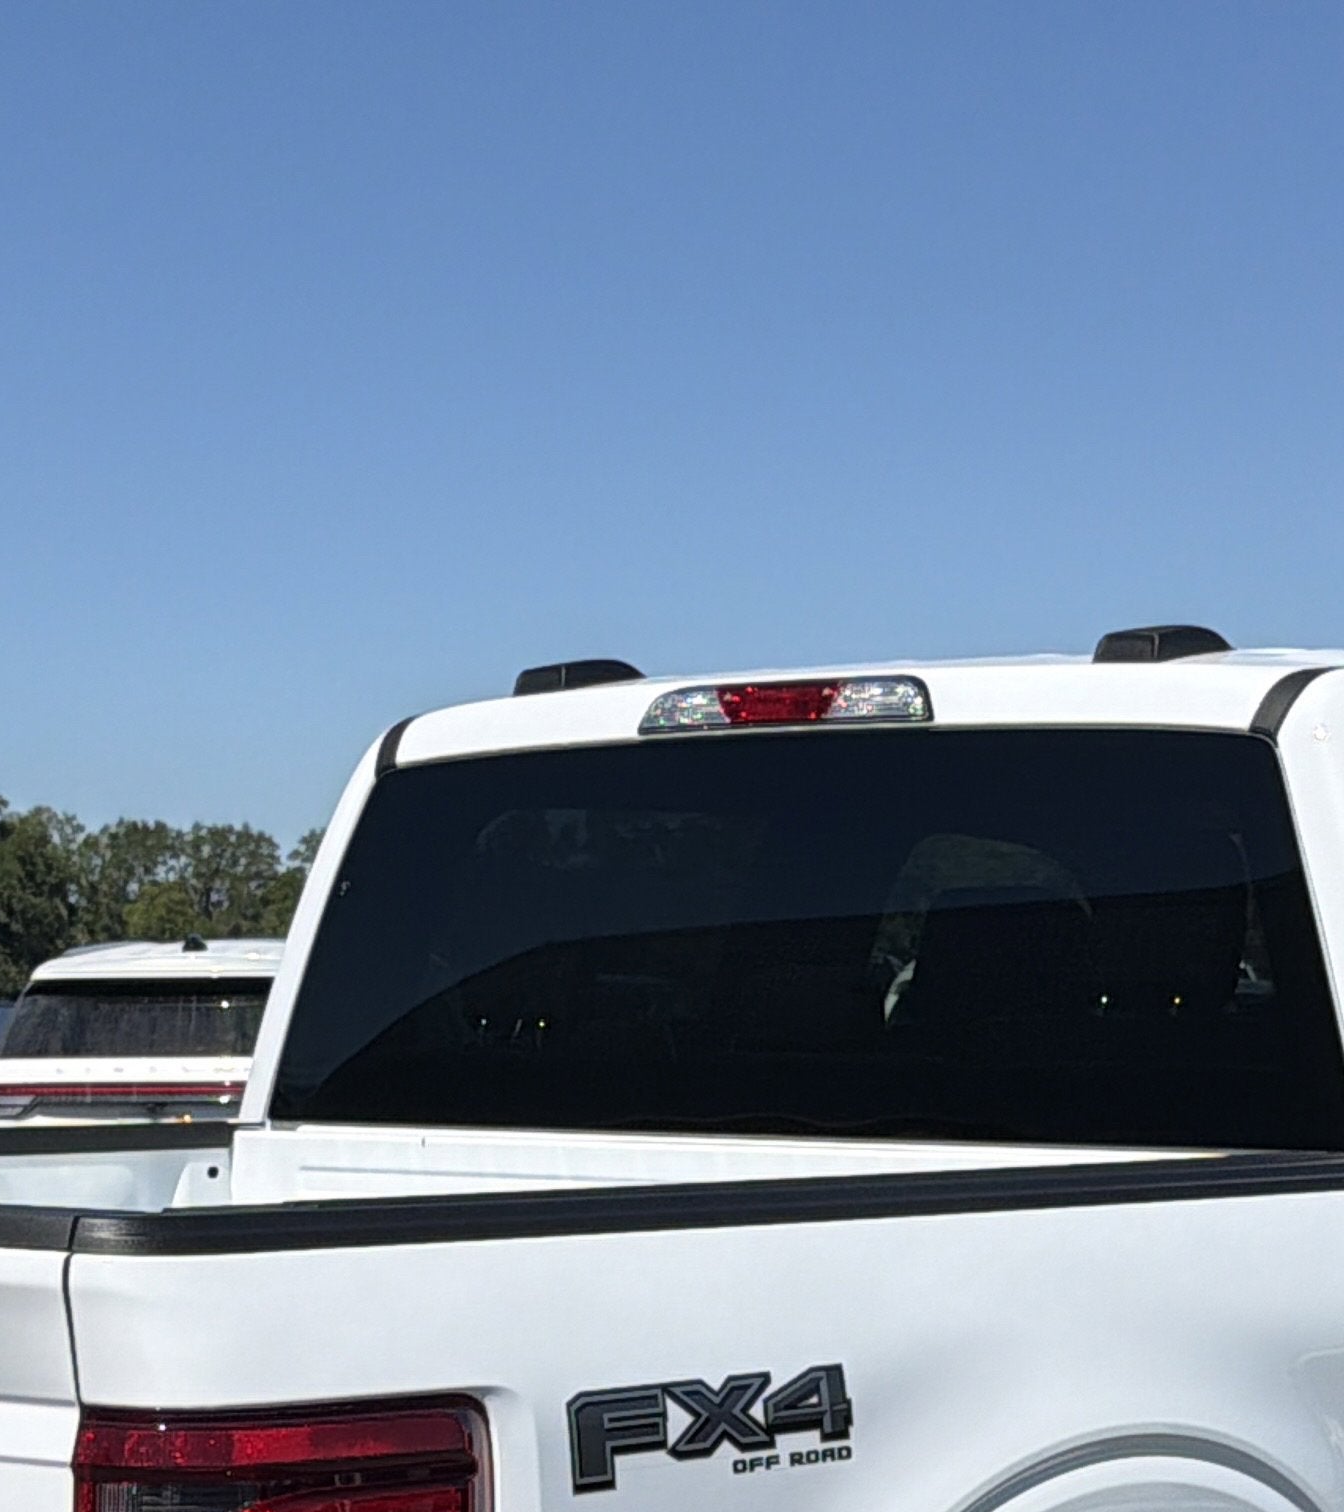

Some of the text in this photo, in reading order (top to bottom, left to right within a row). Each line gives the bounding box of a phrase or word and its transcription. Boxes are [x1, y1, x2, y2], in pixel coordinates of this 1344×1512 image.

[565, 1362, 854, 1496] FX4
[732, 1445, 853, 1475] OFF ROAD
